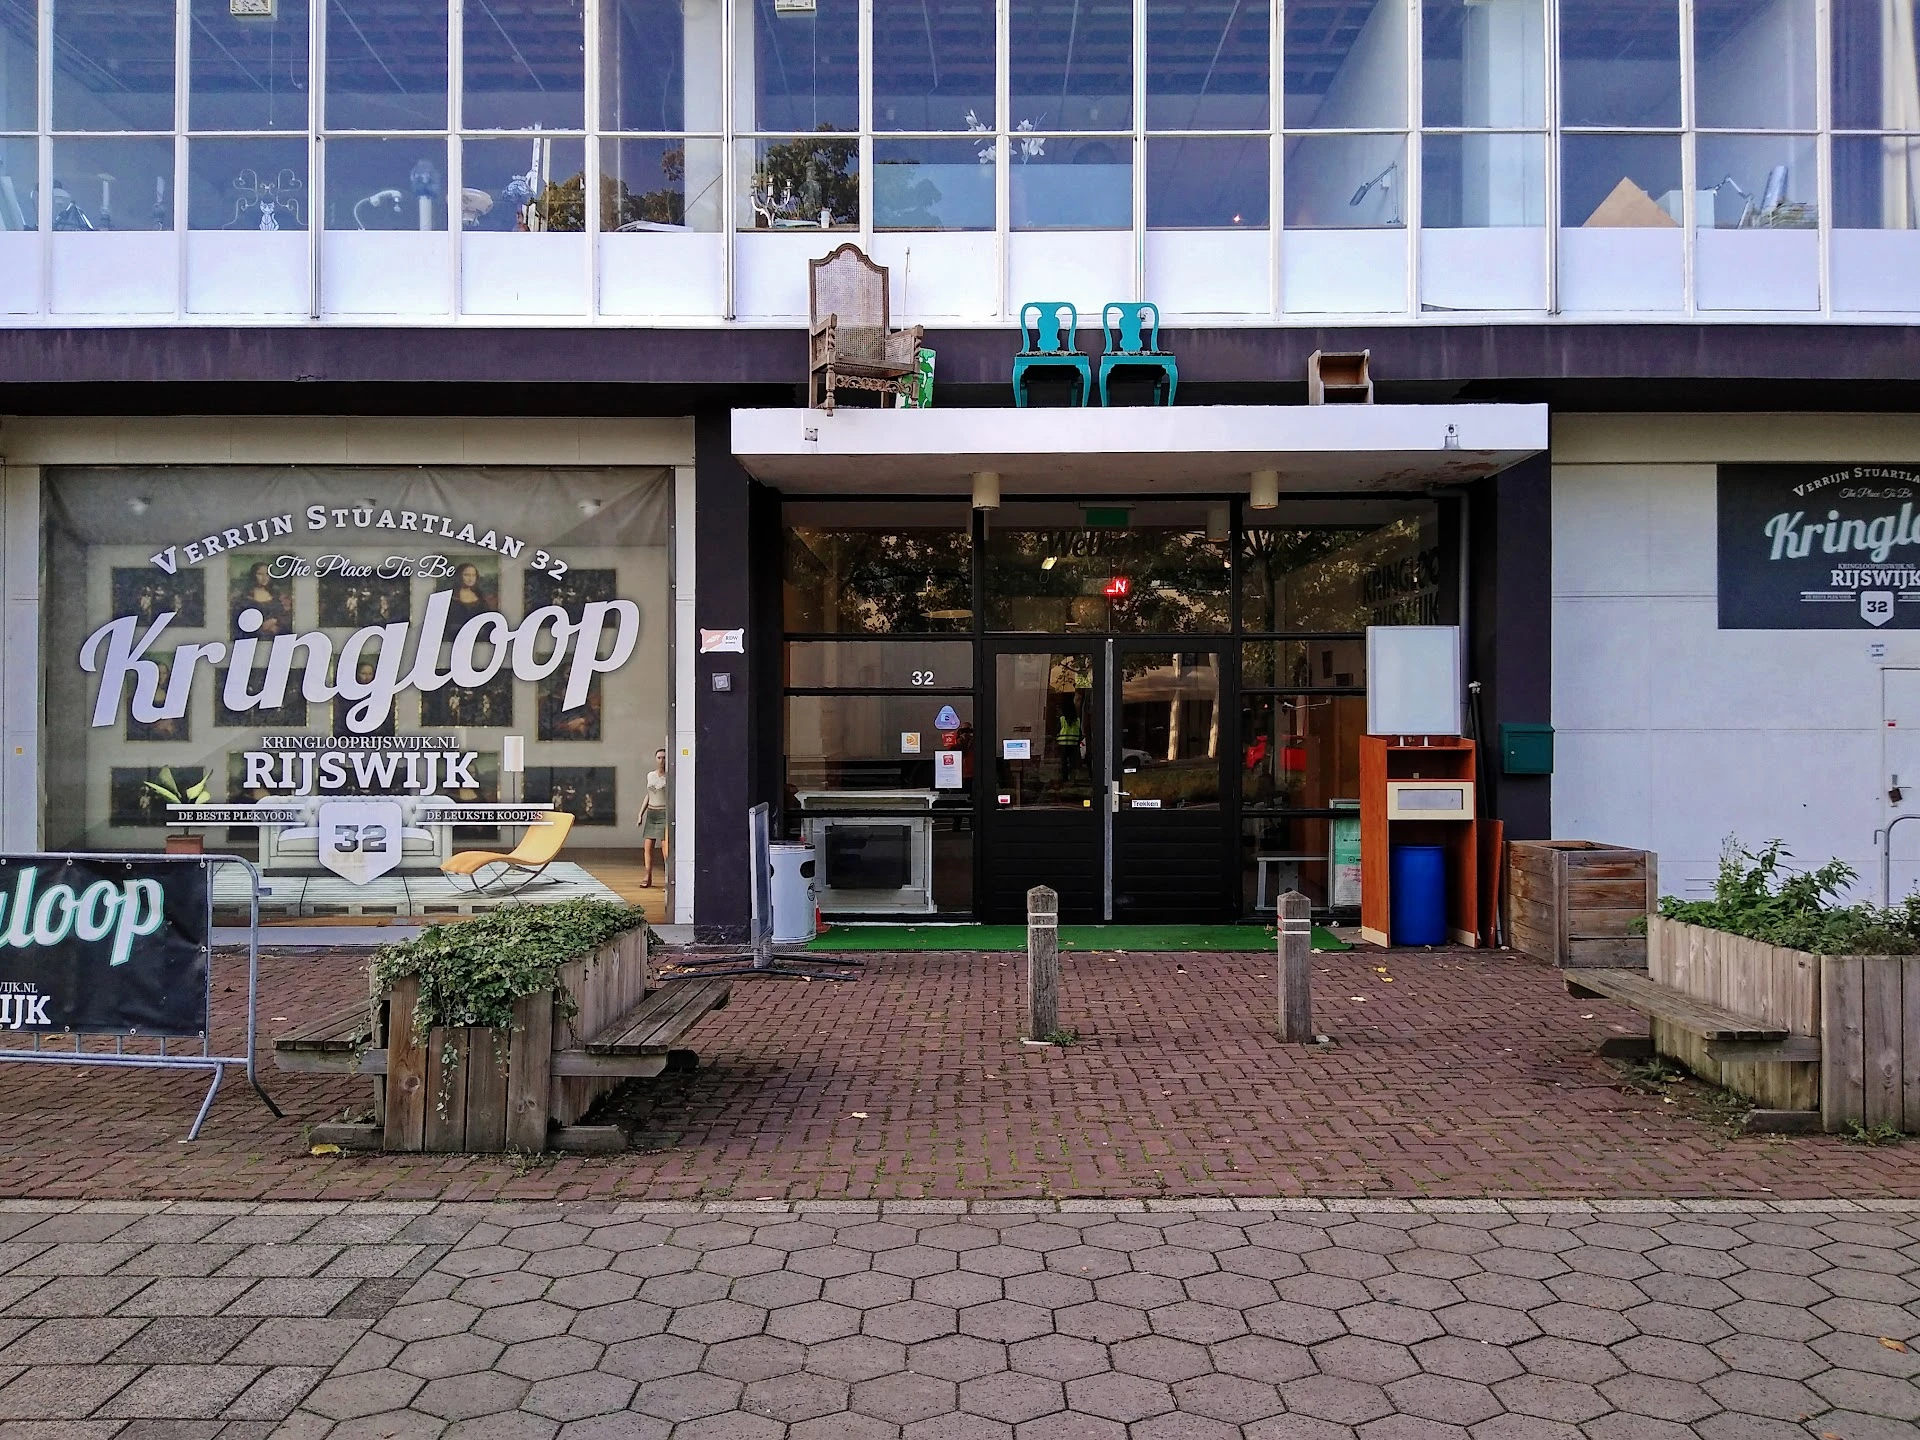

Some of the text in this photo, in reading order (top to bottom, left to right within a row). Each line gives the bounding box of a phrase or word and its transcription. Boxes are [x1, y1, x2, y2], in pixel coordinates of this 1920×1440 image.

[1792, 472, 1850, 497] VERRIJN
[1897, 488, 1913, 498] Be
[150, 505, 569, 581] VERRIJN STUARTLAAN 32
[267, 553, 456, 580] The Place To Be
[1866, 600, 1888, 613] 32
[79, 588, 640, 728] Kringloop
[911, 670, 935, 686] 32
[261, 736, 460, 750] KRINGLOOPRIJSWIJK.NL
[243, 751, 480, 796] RIJSWIJK
[178, 811, 294, 821] DE BESTE PLEK VOOR
[426, 811, 543, 822] DE LEUKSTE KOOPJES
[334, 825, 387, 853] 32
[0, 866, 164, 967] loop
